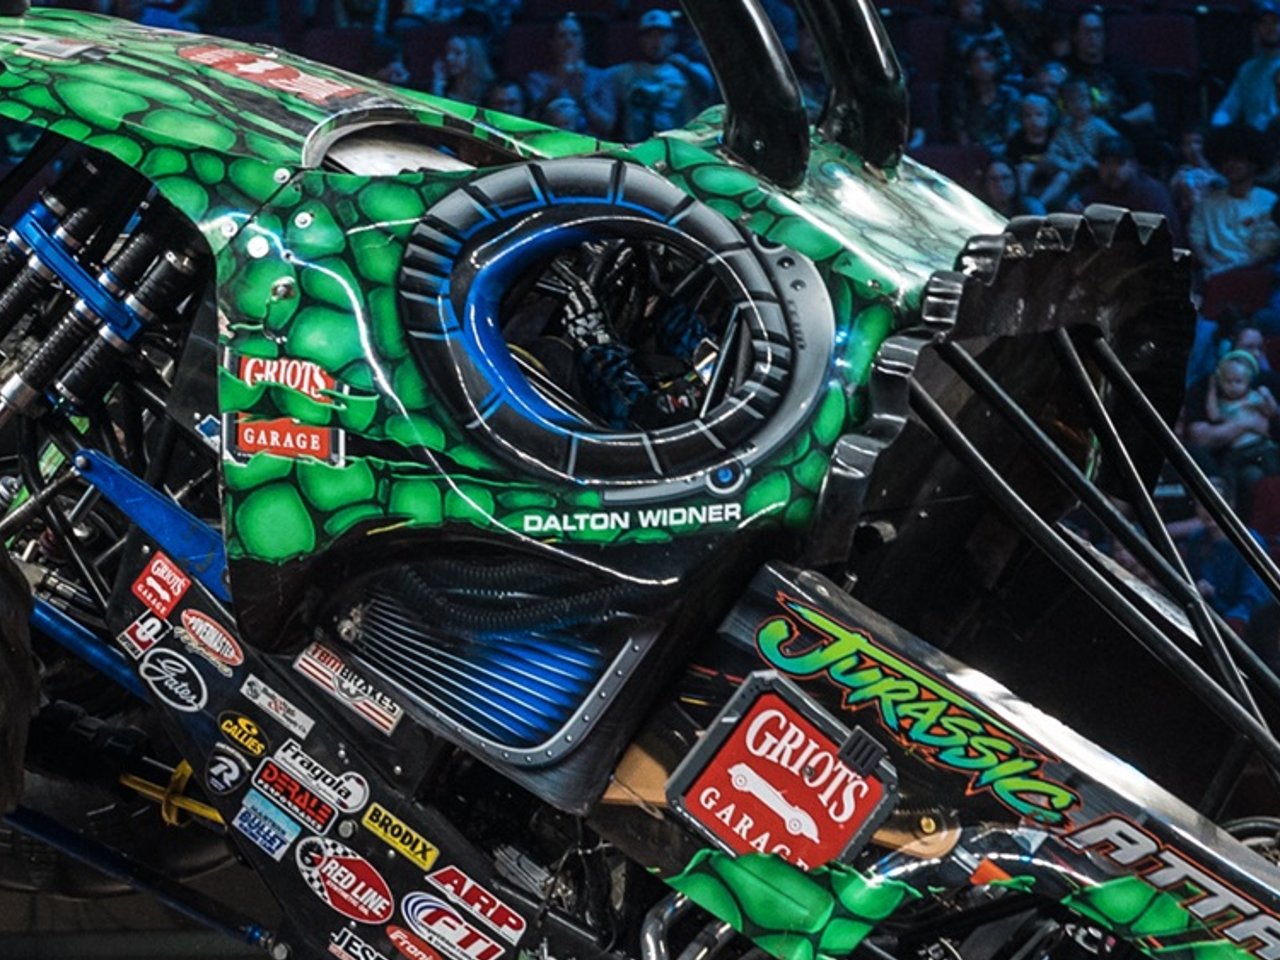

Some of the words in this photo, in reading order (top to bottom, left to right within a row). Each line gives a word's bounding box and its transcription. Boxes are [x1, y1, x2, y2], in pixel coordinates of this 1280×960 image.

[243, 428, 321, 451] GARAGE
[523, 511, 630, 532] DALTON
[638, 503, 741, 528] WIDNER
[136, 583, 167, 614] GARAGE
[141, 654, 198, 707] Gates
[339, 665, 400, 713] BRAKES
[220, 718, 266, 756] CALLIES
[259, 762, 333, 824] DERALE
[280, 740, 353, 801] Fragola
[238, 809, 288, 851] BULLET
[257, 778, 323, 831] PERFORMANCE
[368, 807, 433, 862] BRODIX
[321, 858, 357, 890] RED
[350, 879, 391, 918] LINE
[433, 869, 524, 933] ARP
